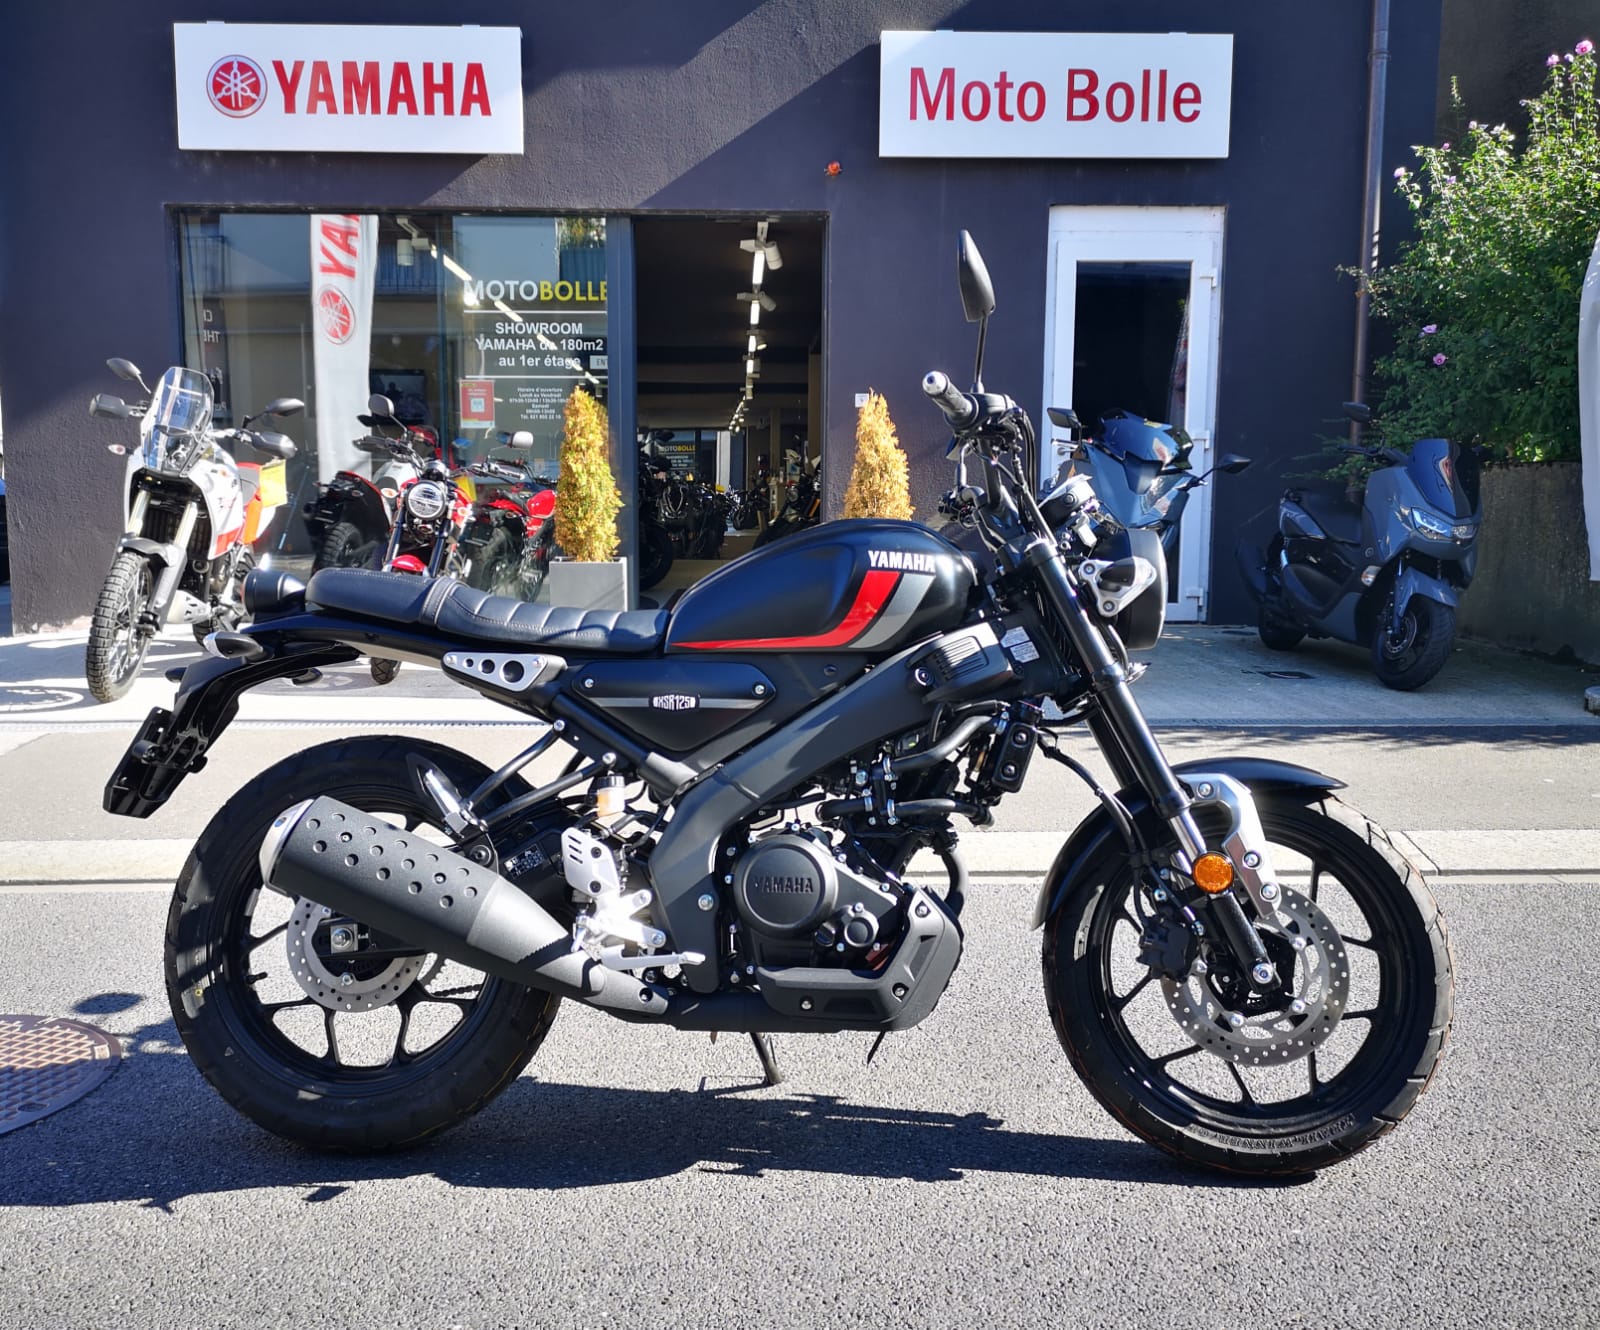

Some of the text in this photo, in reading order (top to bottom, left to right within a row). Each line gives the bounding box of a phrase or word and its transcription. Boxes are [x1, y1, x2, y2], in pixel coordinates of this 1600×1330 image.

[272, 60, 492, 116] YAMAHA
[909, 67, 1202, 123] Moto Bolle
[319, 214, 360, 281] YA
[495, 322, 583, 335] SHOWROOM
[475, 338, 536, 351] YAMAHA
[560, 339, 604, 351] 180m2
[498, 356, 515, 367] au
[519, 355, 541, 367] 1er
[867, 550, 937, 573] YAMAHA
[657, 694, 690, 711] XSR125
[752, 876, 814, 894] YAMAHA
